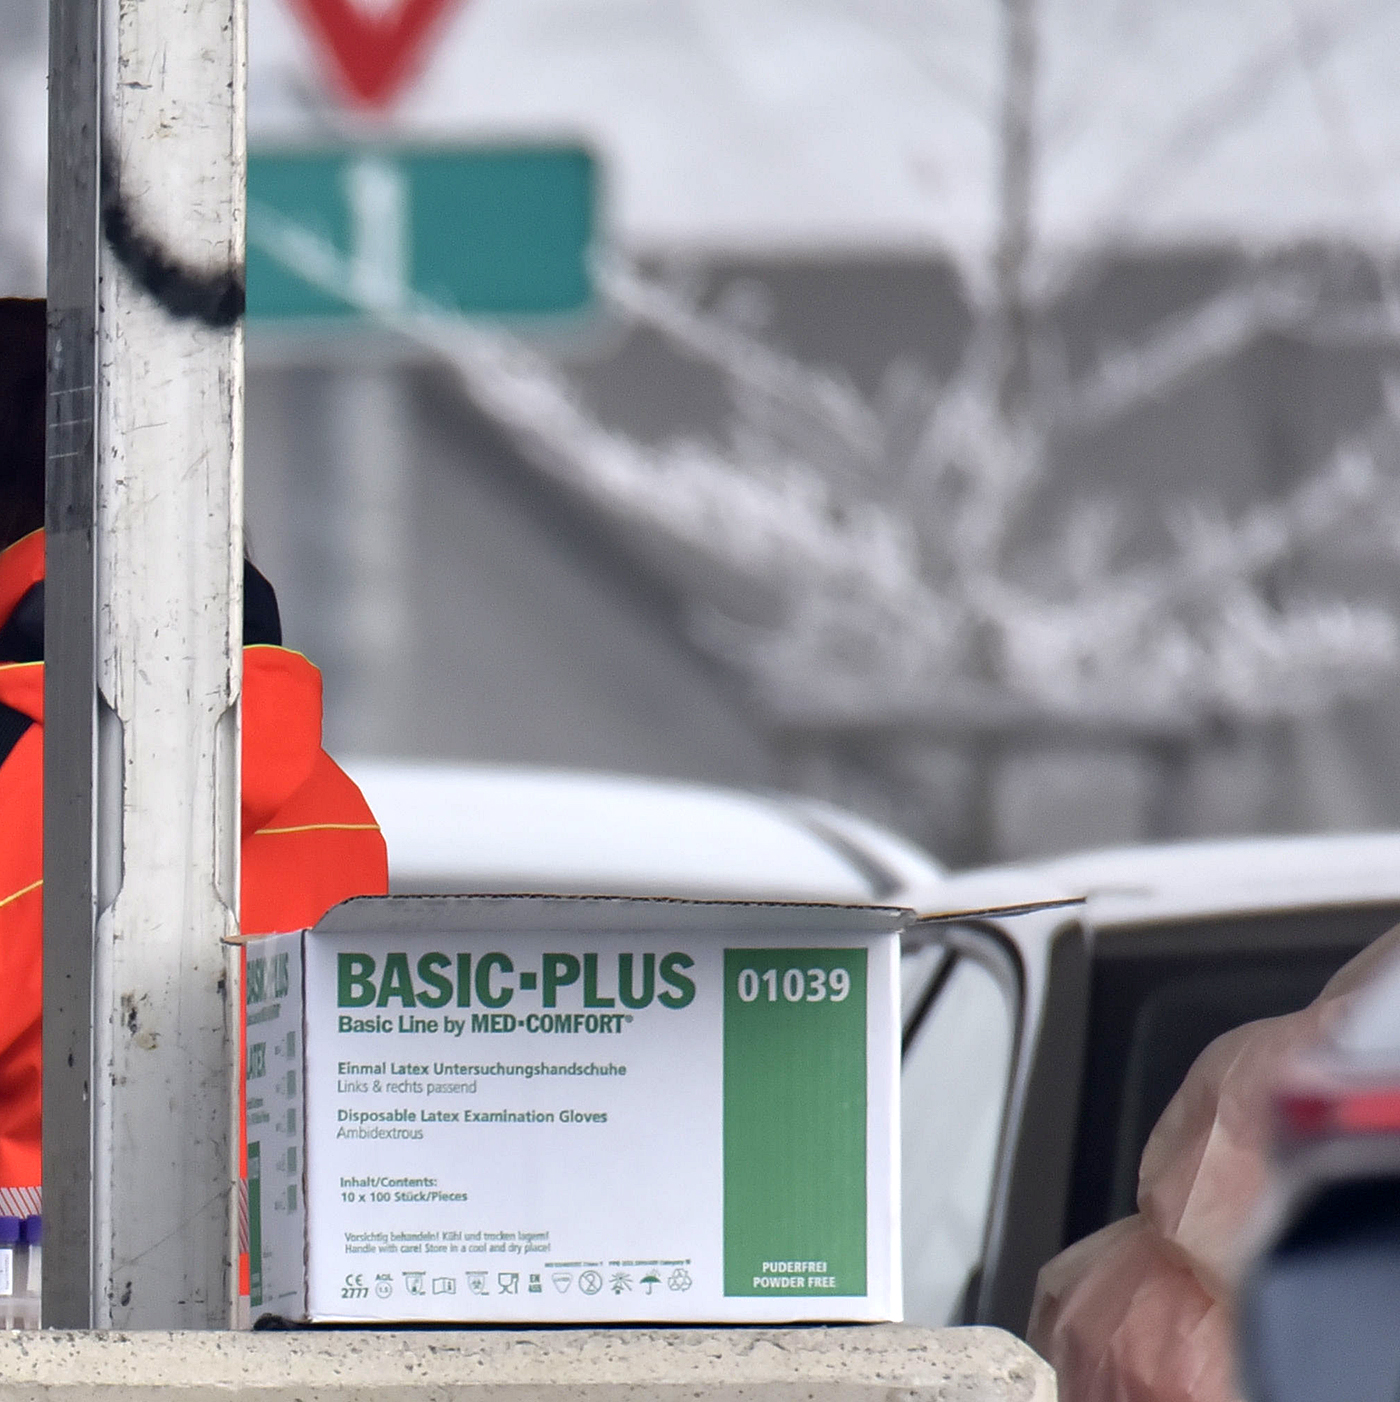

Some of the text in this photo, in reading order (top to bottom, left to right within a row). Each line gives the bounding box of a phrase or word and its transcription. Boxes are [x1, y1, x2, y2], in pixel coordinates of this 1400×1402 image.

[737, 968, 851, 1003] 01039
[338, 1015, 393, 1034] Basic
[400, 1015, 438, 1034] Line
[443, 1015, 465, 1038] by
[338, 1062, 627, 1079] Einmal Latex Untersuchungshandschuhe
[337, 1080, 478, 1096] Links & rechts passend
[337, 1109, 608, 1124] Disposable Latex Examination Gloves
[336, 1126, 424, 1140] Ambidextrous
[340, 1177, 437, 1189] Inhalt/Contents:
[341, 1191, 468, 1203] 10 x 100 Stück/Pieces
[344, 1231, 388, 1244] Vorsichtig
[464, 1231, 482, 1241] und
[345, 1244, 376, 1253] Handle
[378, 1243, 398, 1253] with
[400, 1243, 422, 1253] care!
[425, 1243, 448, 1253] Store
[450, 1243, 458, 1252] in
[468, 1242, 487, 1252] cool
[489, 1242, 506, 1252] and
[508, 1242, 522, 1255] dry
[524, 1242, 551, 1255] place!
[762, 1261, 827, 1274] PUDERFREI
[753, 1276, 836, 1289] POWDER FREE
[341, 1287, 369, 1299] 2777
